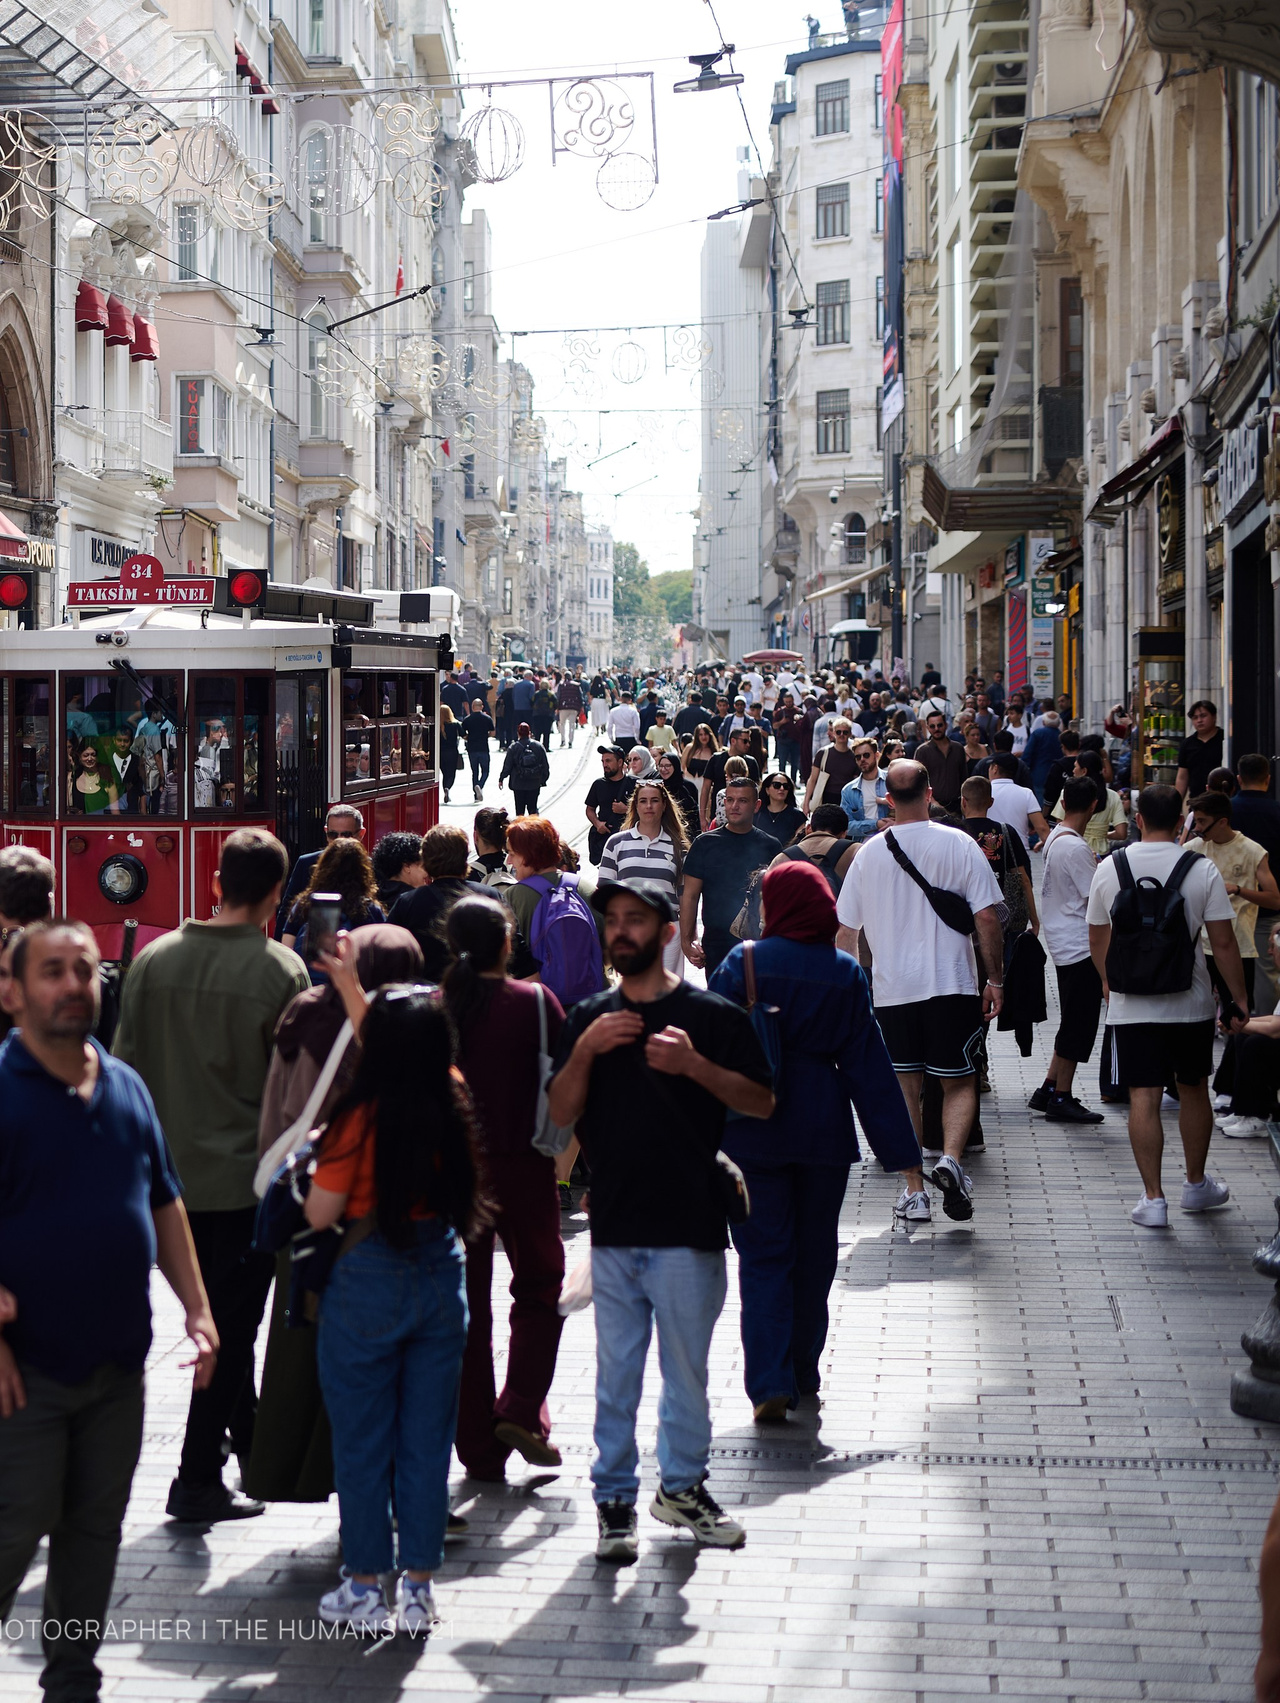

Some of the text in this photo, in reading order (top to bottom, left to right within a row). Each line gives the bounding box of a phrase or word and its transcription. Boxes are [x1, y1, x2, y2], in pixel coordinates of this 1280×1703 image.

[187, 380, 199, 452] KUAFÖR
[104, 541, 121, 568] POLO
[131, 564, 152, 579] 34
[75, 584, 137, 601] TAKSİM
[156, 584, 208, 601] TÜNEL
